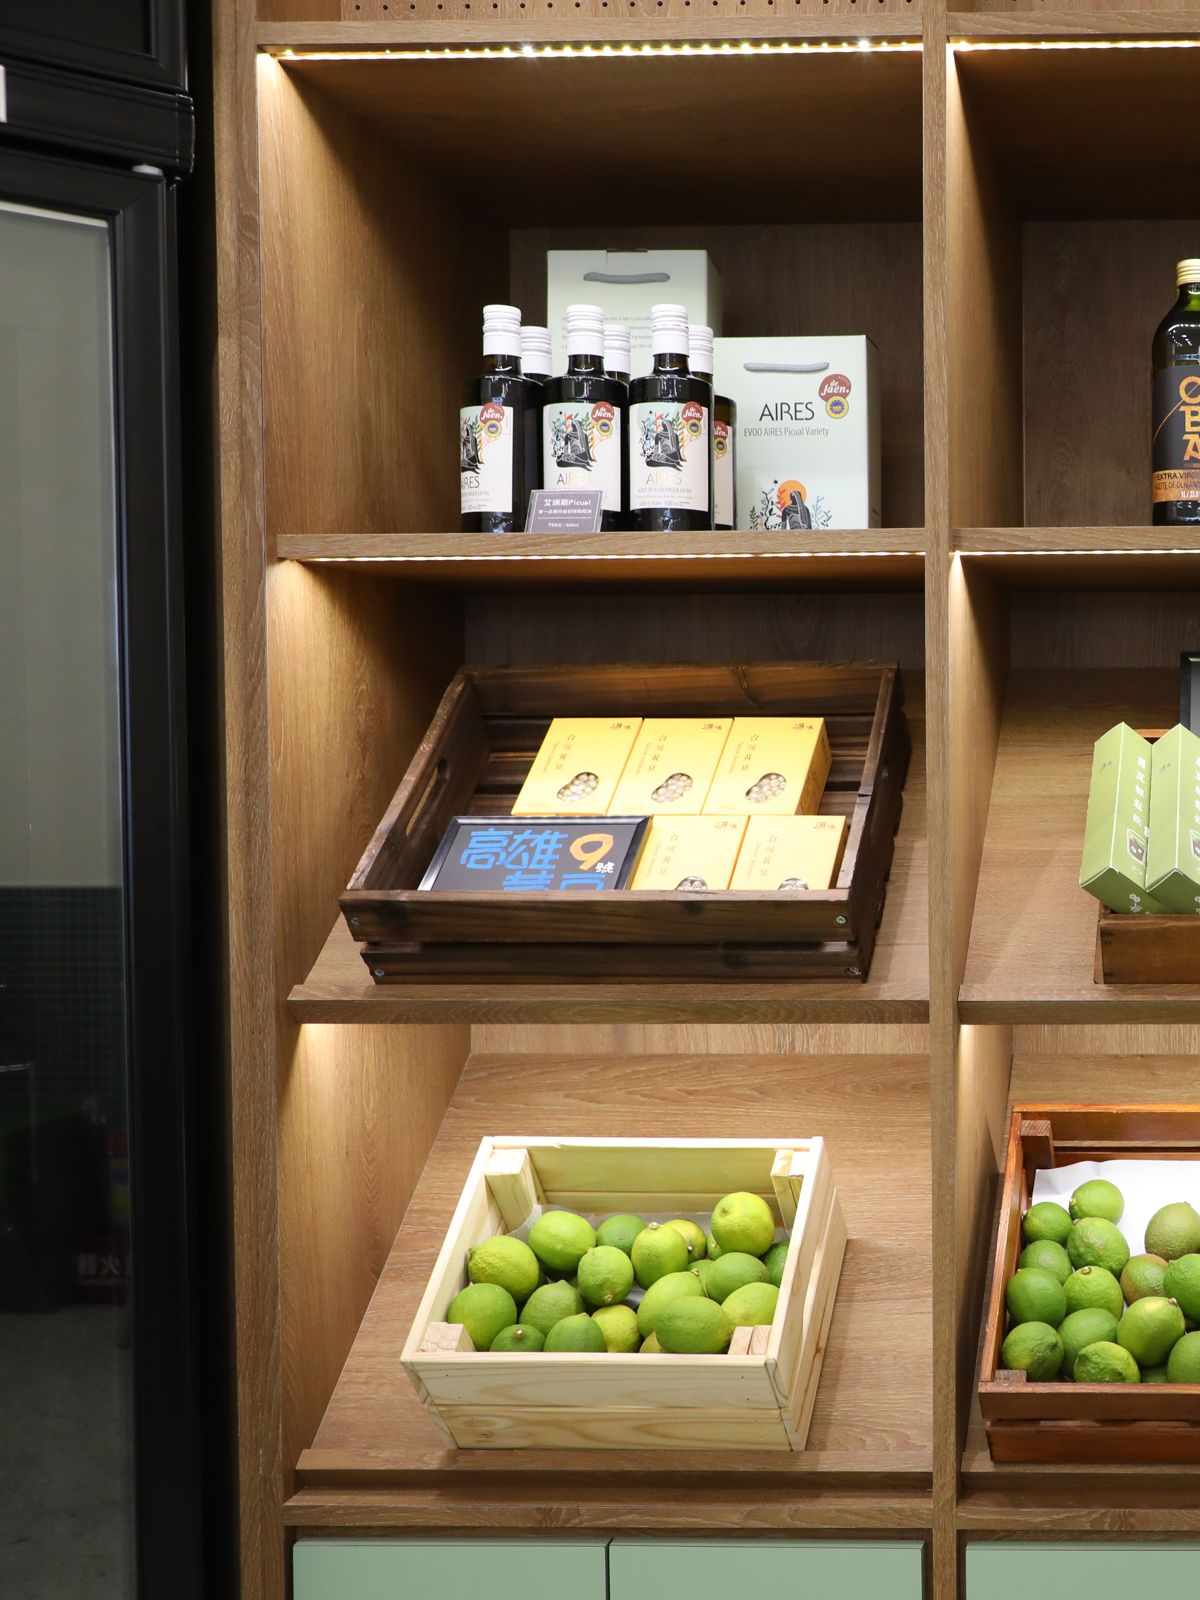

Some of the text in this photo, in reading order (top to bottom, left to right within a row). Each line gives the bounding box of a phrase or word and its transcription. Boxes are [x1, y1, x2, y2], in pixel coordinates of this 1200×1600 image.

[759, 402, 815, 421] AIRES
[744, 427, 829, 438] EVOO AIRES Picual Variety
